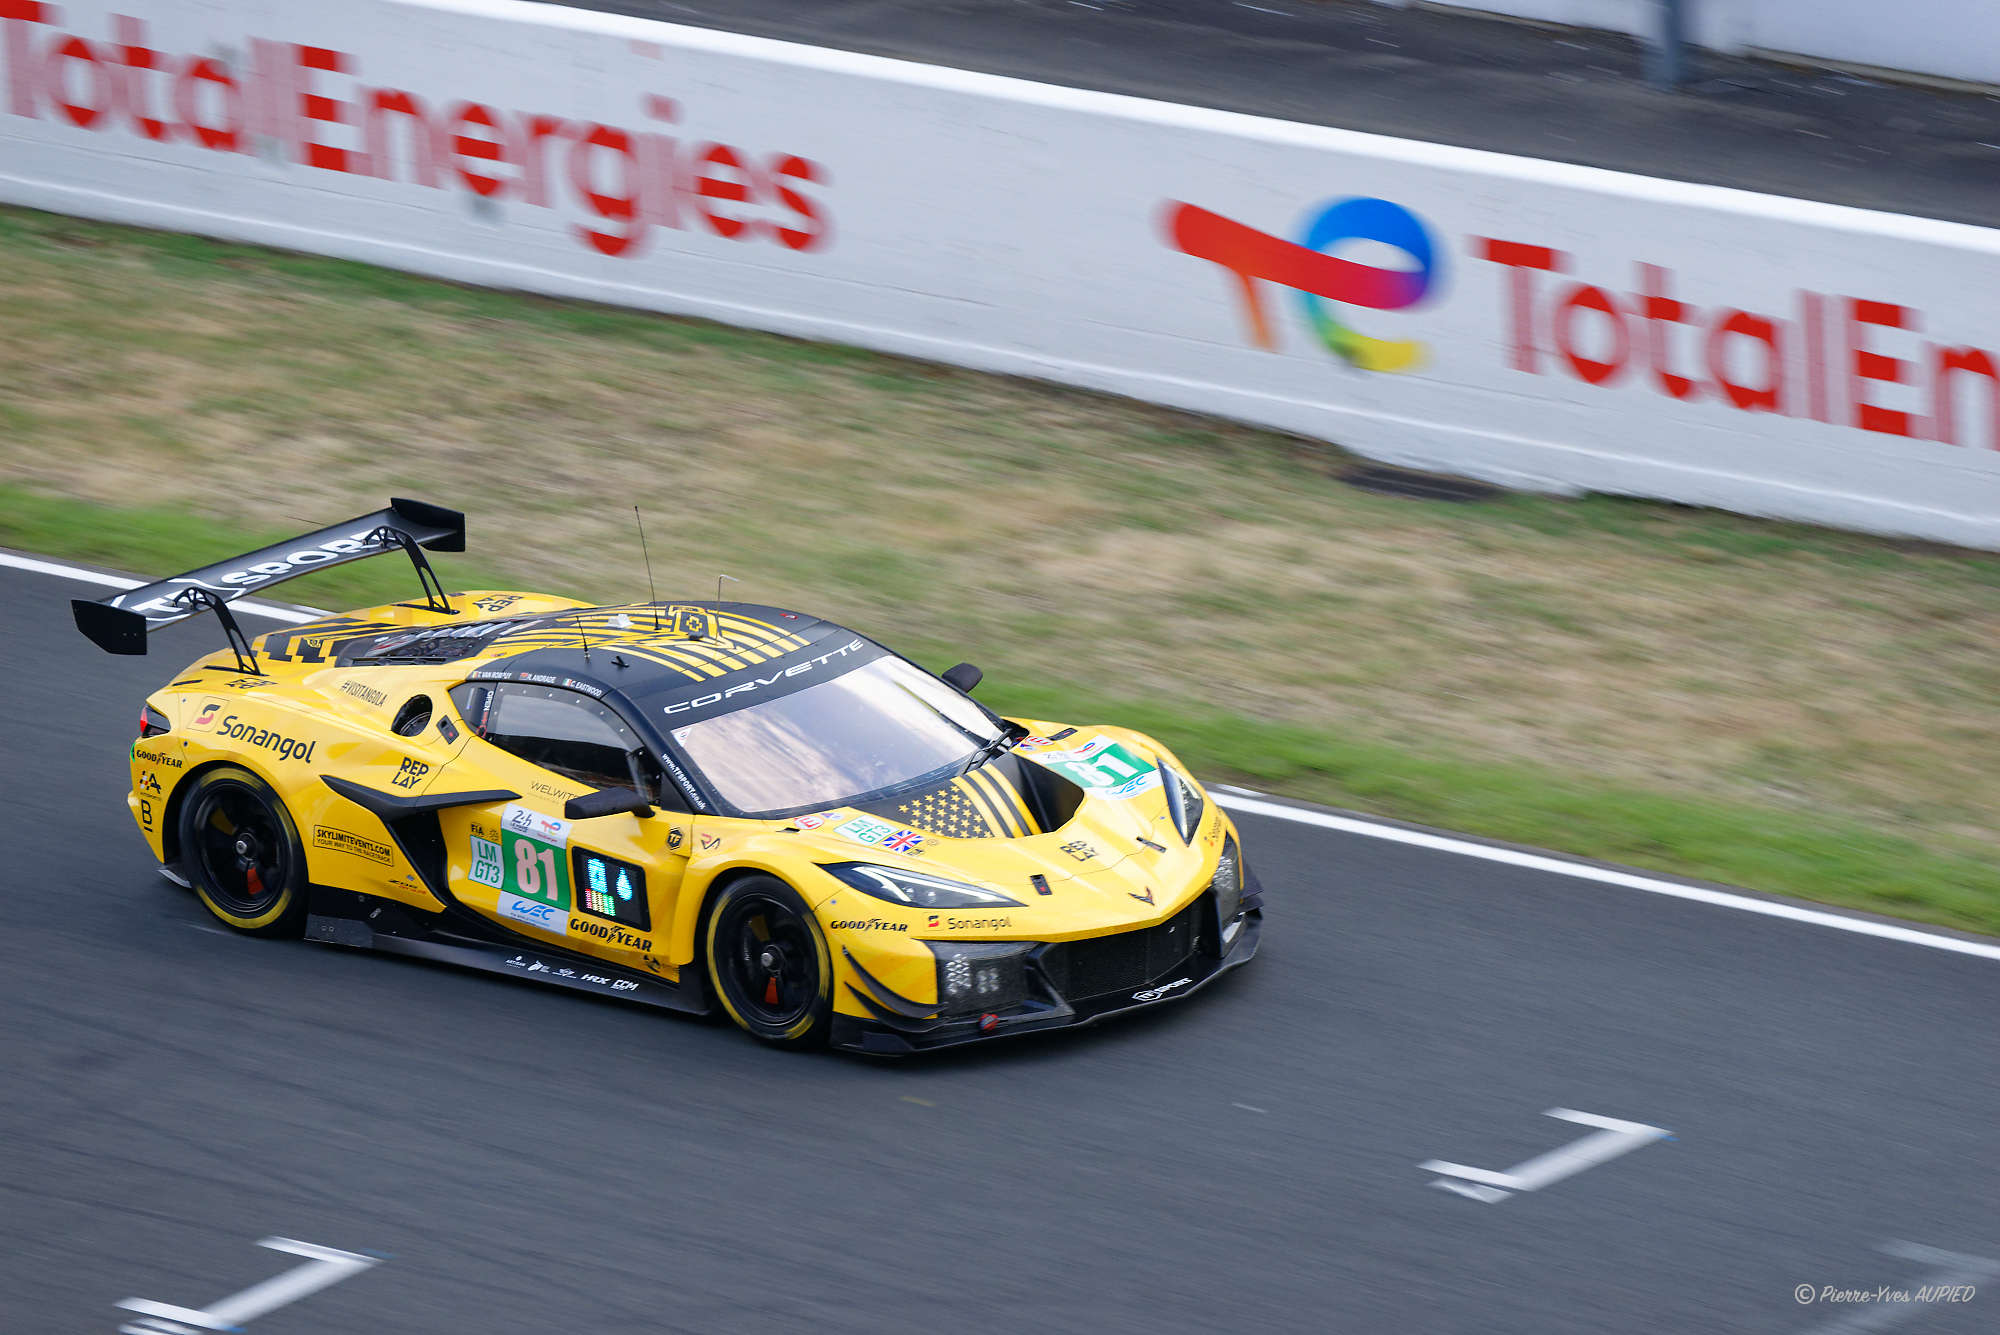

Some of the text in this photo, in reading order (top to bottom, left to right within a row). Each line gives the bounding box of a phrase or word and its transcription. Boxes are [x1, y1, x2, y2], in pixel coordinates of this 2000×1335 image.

[0, 0, 833, 257] TotalEnergies
[664, 638, 864, 714] CORVETTE
[341, 680, 388, 707] #VISITANGOLA
[217, 715, 317, 764] Sonangol
[400, 756, 429, 777] REP
[391, 771, 422, 789] LAY
[530, 782, 577, 800] WELWIT
[477, 841, 497, 864] LM
[475, 860, 500, 884] GT3
[514, 839, 558, 901] 81
[511, 900, 555, 921] WEC
[947, 916, 1012, 932] Sonangol
